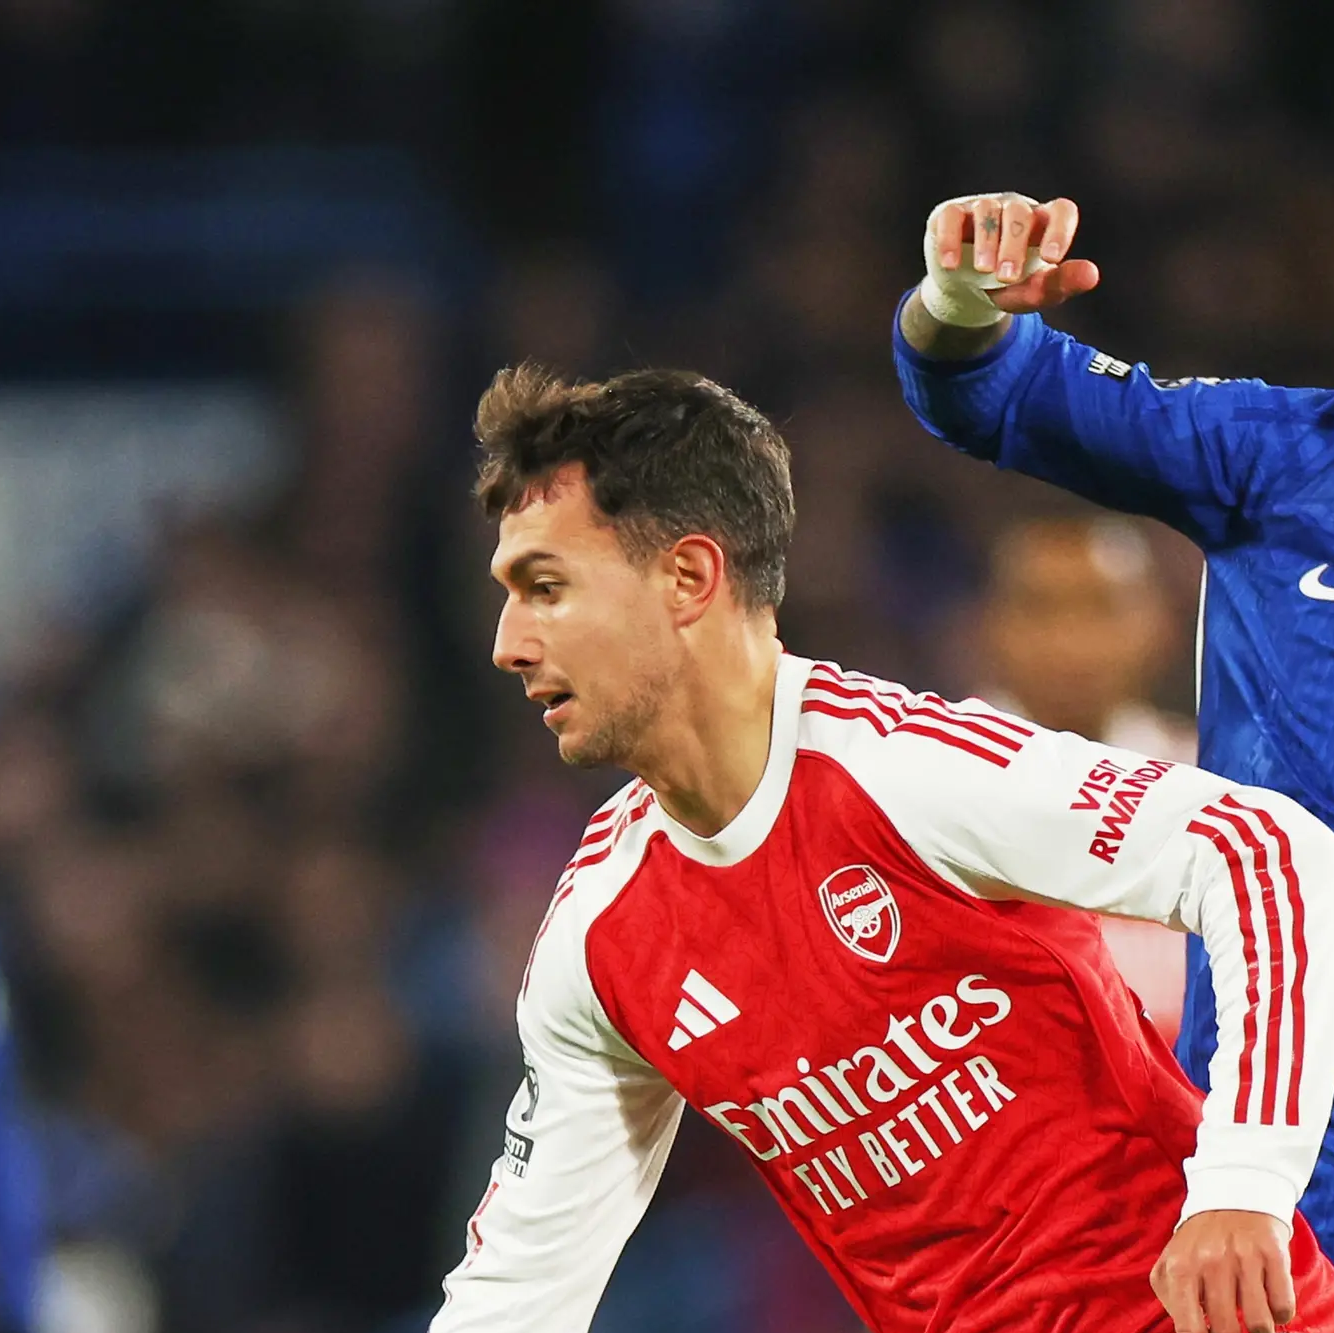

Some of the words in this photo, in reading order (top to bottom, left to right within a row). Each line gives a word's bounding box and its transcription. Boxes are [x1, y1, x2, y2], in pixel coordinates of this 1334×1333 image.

[1070, 759, 1127, 810] VISIT
[1088, 760, 1176, 865] RWANDA
[831, 876, 877, 910] Arsenal
[703, 973, 1012, 1161] Emirates
[793, 1145, 868, 1215] FLY
[858, 1055, 1017, 1188] BETTER
